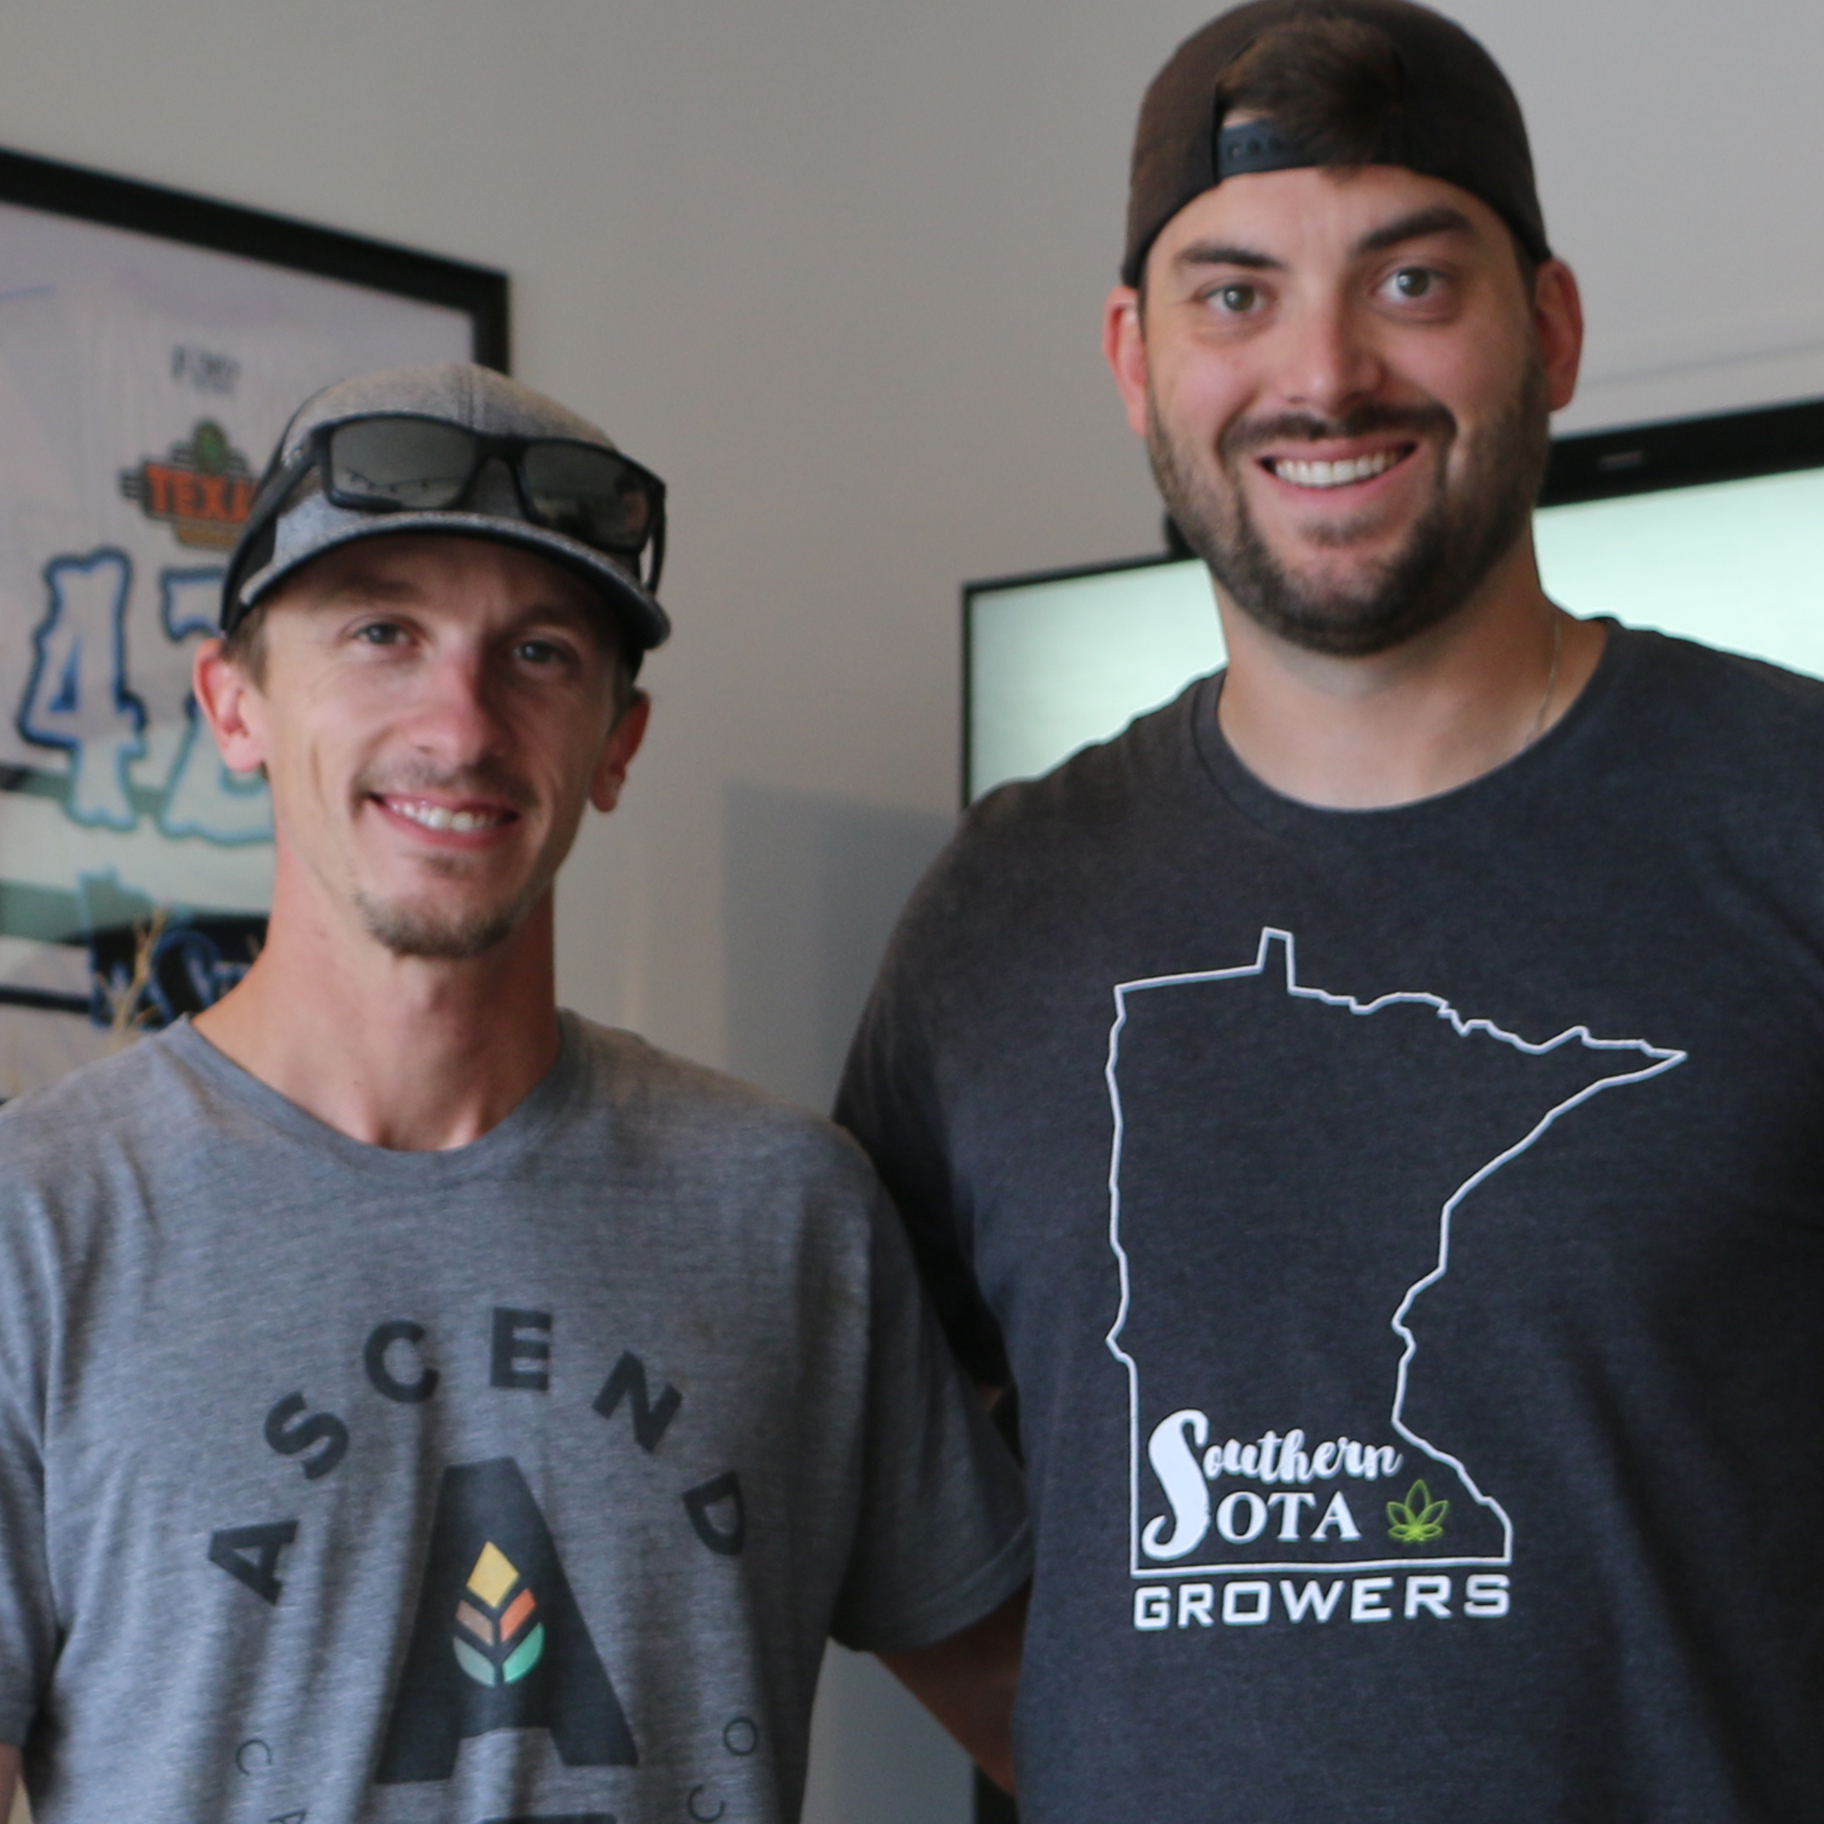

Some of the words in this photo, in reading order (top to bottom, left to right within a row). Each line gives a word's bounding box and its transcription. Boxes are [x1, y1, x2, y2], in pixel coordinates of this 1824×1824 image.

[208, 1306, 746, 1606] ASCEND
[1141, 1408, 1404, 1561] Southern
[1133, 1574, 1511, 1631] GROWERS
